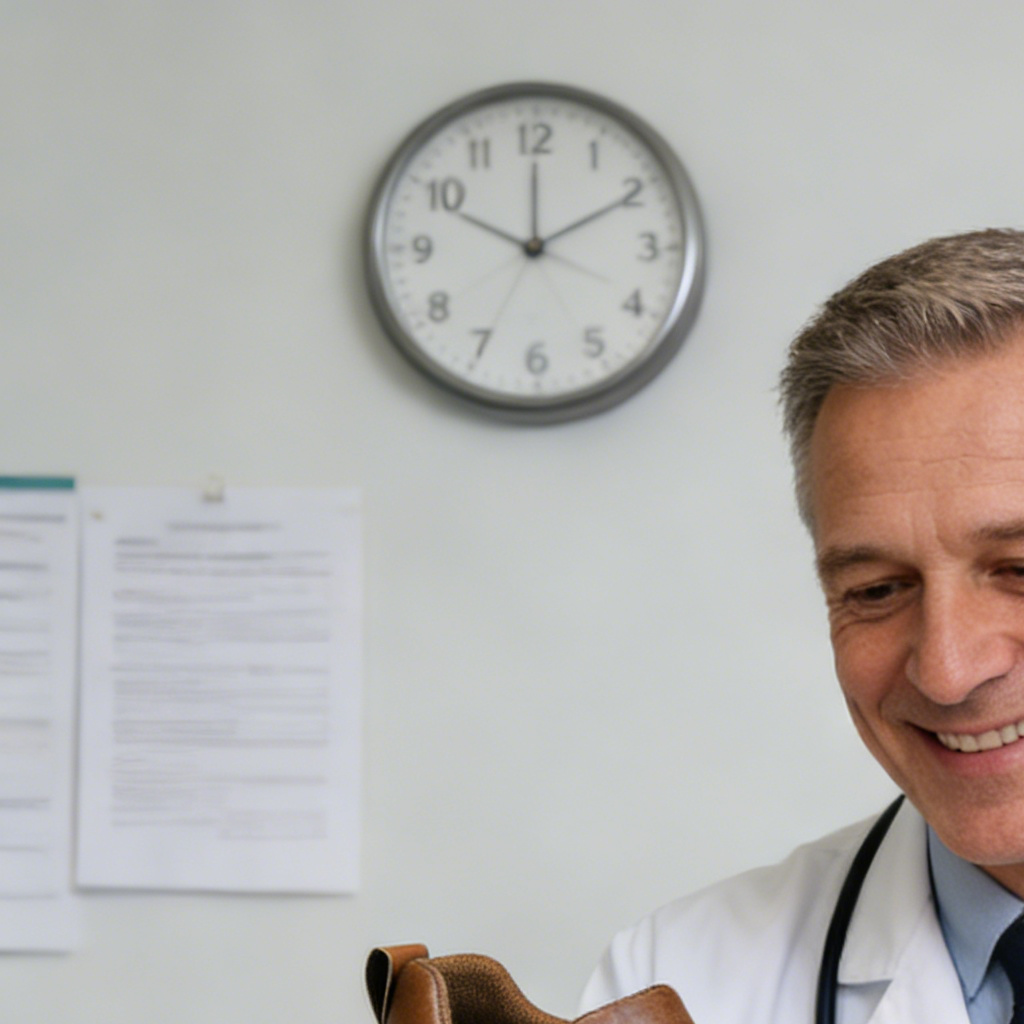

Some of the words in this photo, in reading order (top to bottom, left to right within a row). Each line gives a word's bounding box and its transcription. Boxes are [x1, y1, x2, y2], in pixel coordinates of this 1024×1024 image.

[469, 138, 490, 170] 11
[517, 122, 553, 155] 12
[589, 139, 599, 171] 1
[428, 176, 466, 212] 10
[622, 177, 644, 207] 2
[412, 234, 433, 263] 9
[636, 232, 659, 262] 3
[428, 292, 449, 323] 8
[621, 289, 643, 318] 4
[469, 328, 493, 359] 7
[525, 342, 548, 375] 6
[583, 327, 605, 359] 5
